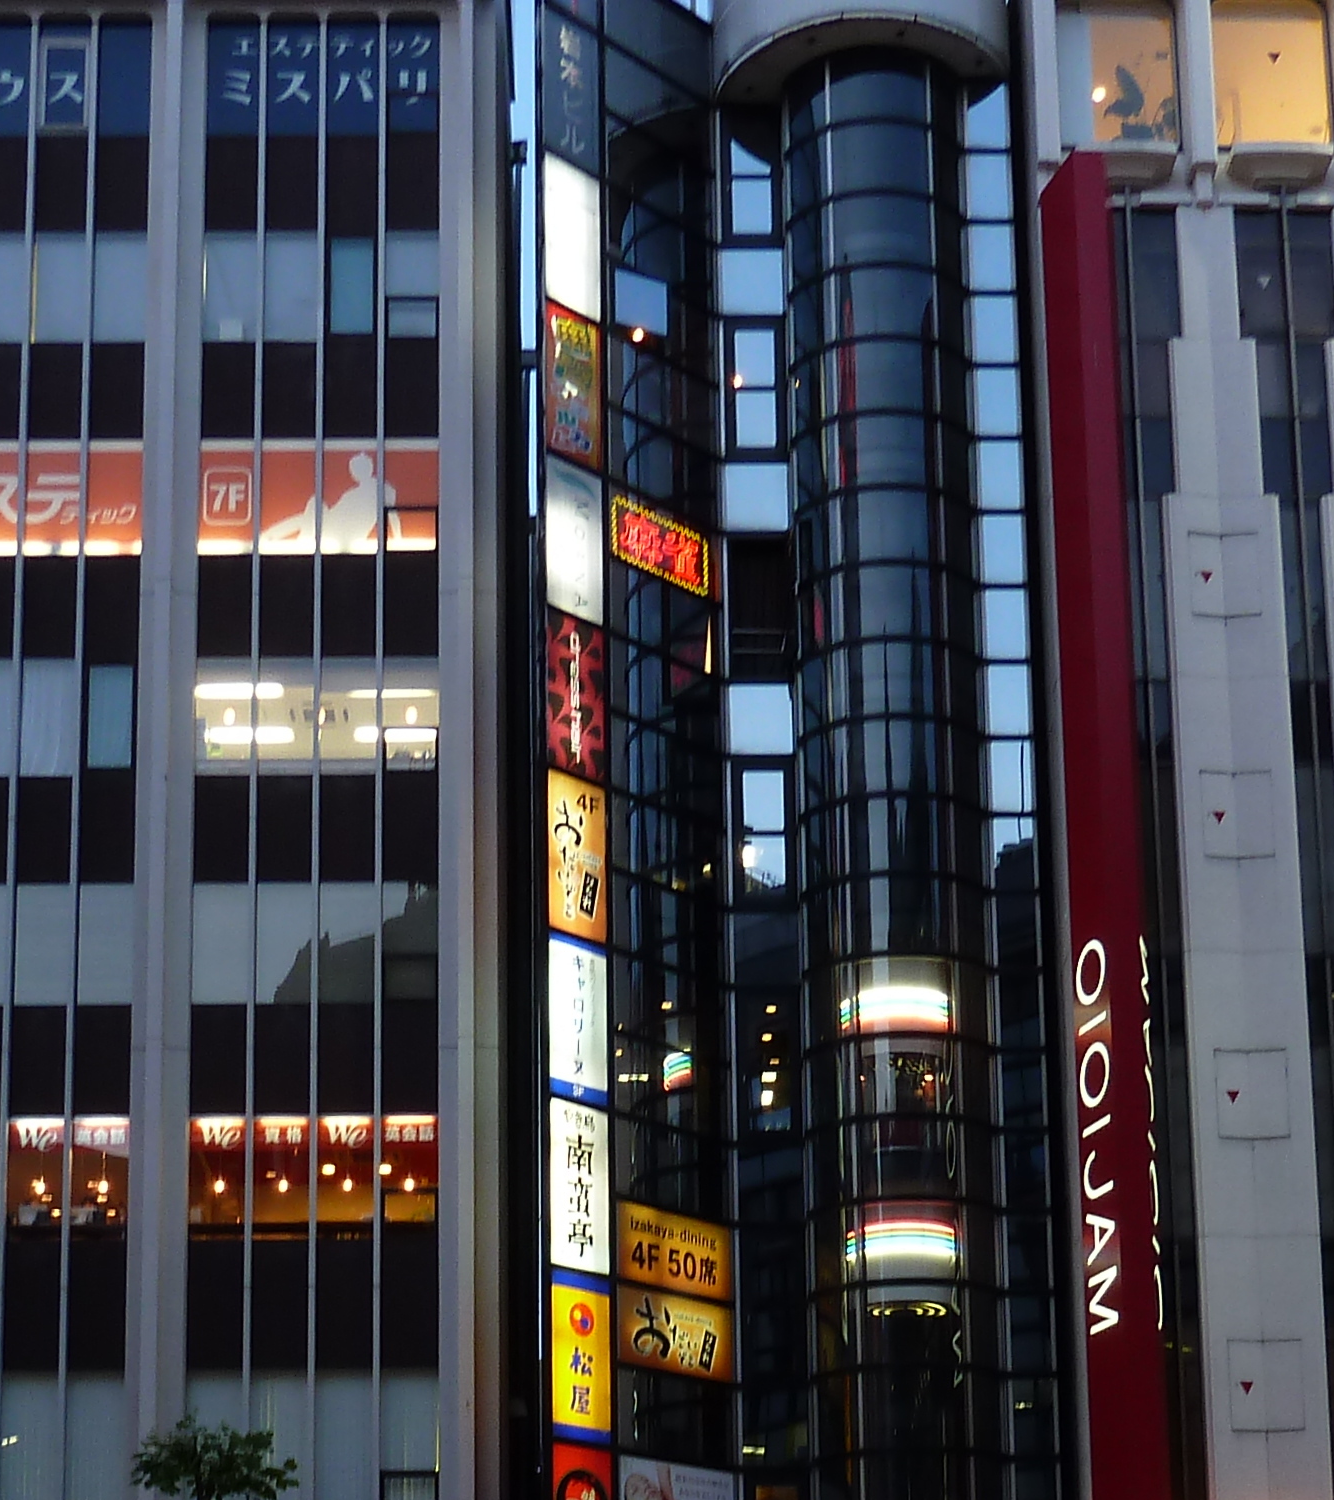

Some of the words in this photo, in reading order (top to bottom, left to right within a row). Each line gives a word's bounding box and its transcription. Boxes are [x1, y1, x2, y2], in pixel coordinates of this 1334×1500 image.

[209, 482, 247, 515] 7F
[576, 793, 599, 814] 4F
[631, 1241, 660, 1272] 4F
[569, 1346, 594, 1415] 松屋
